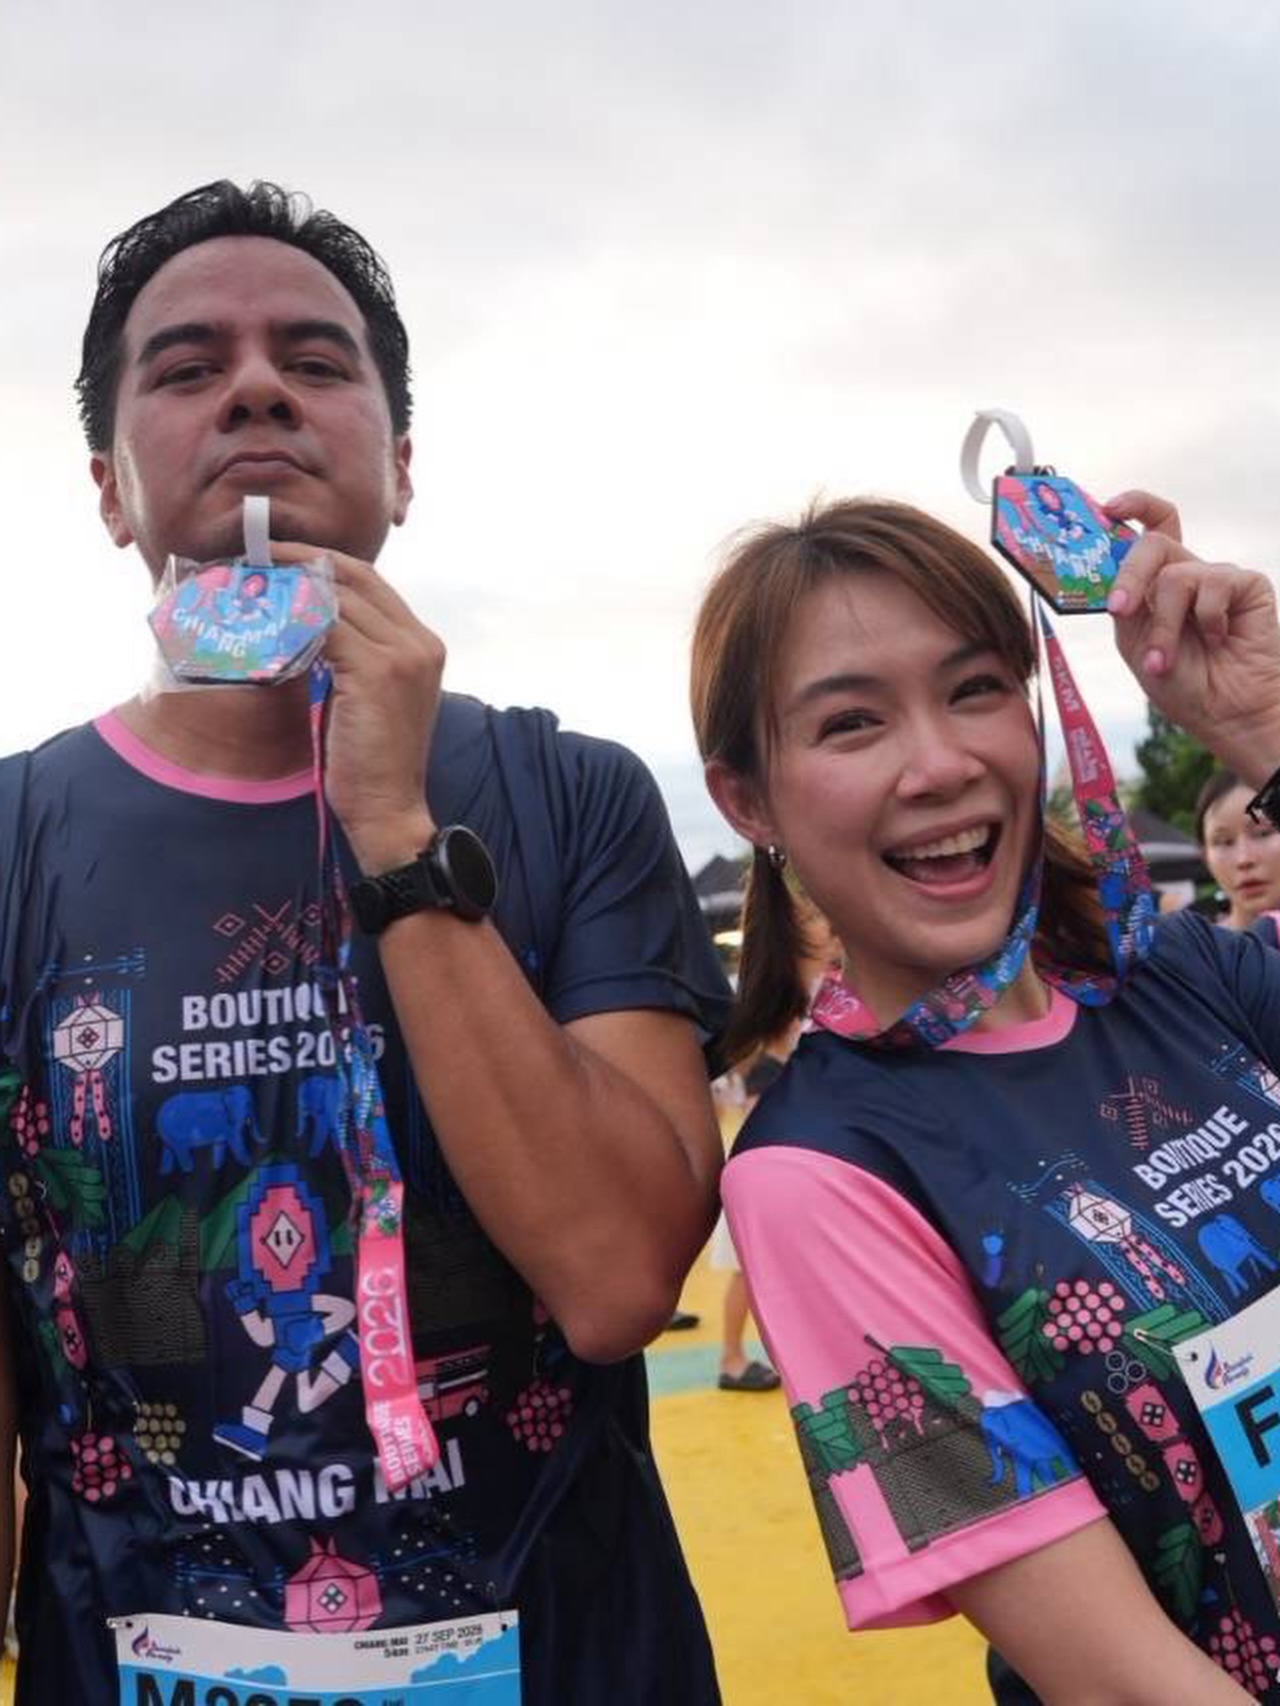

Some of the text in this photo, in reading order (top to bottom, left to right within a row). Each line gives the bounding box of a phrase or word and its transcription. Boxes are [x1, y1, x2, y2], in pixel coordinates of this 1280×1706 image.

[171, 607, 247, 658] CHIANG
[151, 1036, 291, 1083] SERIES
[1132, 1104, 1250, 1191] BOUTIQUE
[360, 1267, 411, 1389] 2026
[168, 1463, 355, 1524] CHIANG
[432, 1628, 455, 1641] SEP
